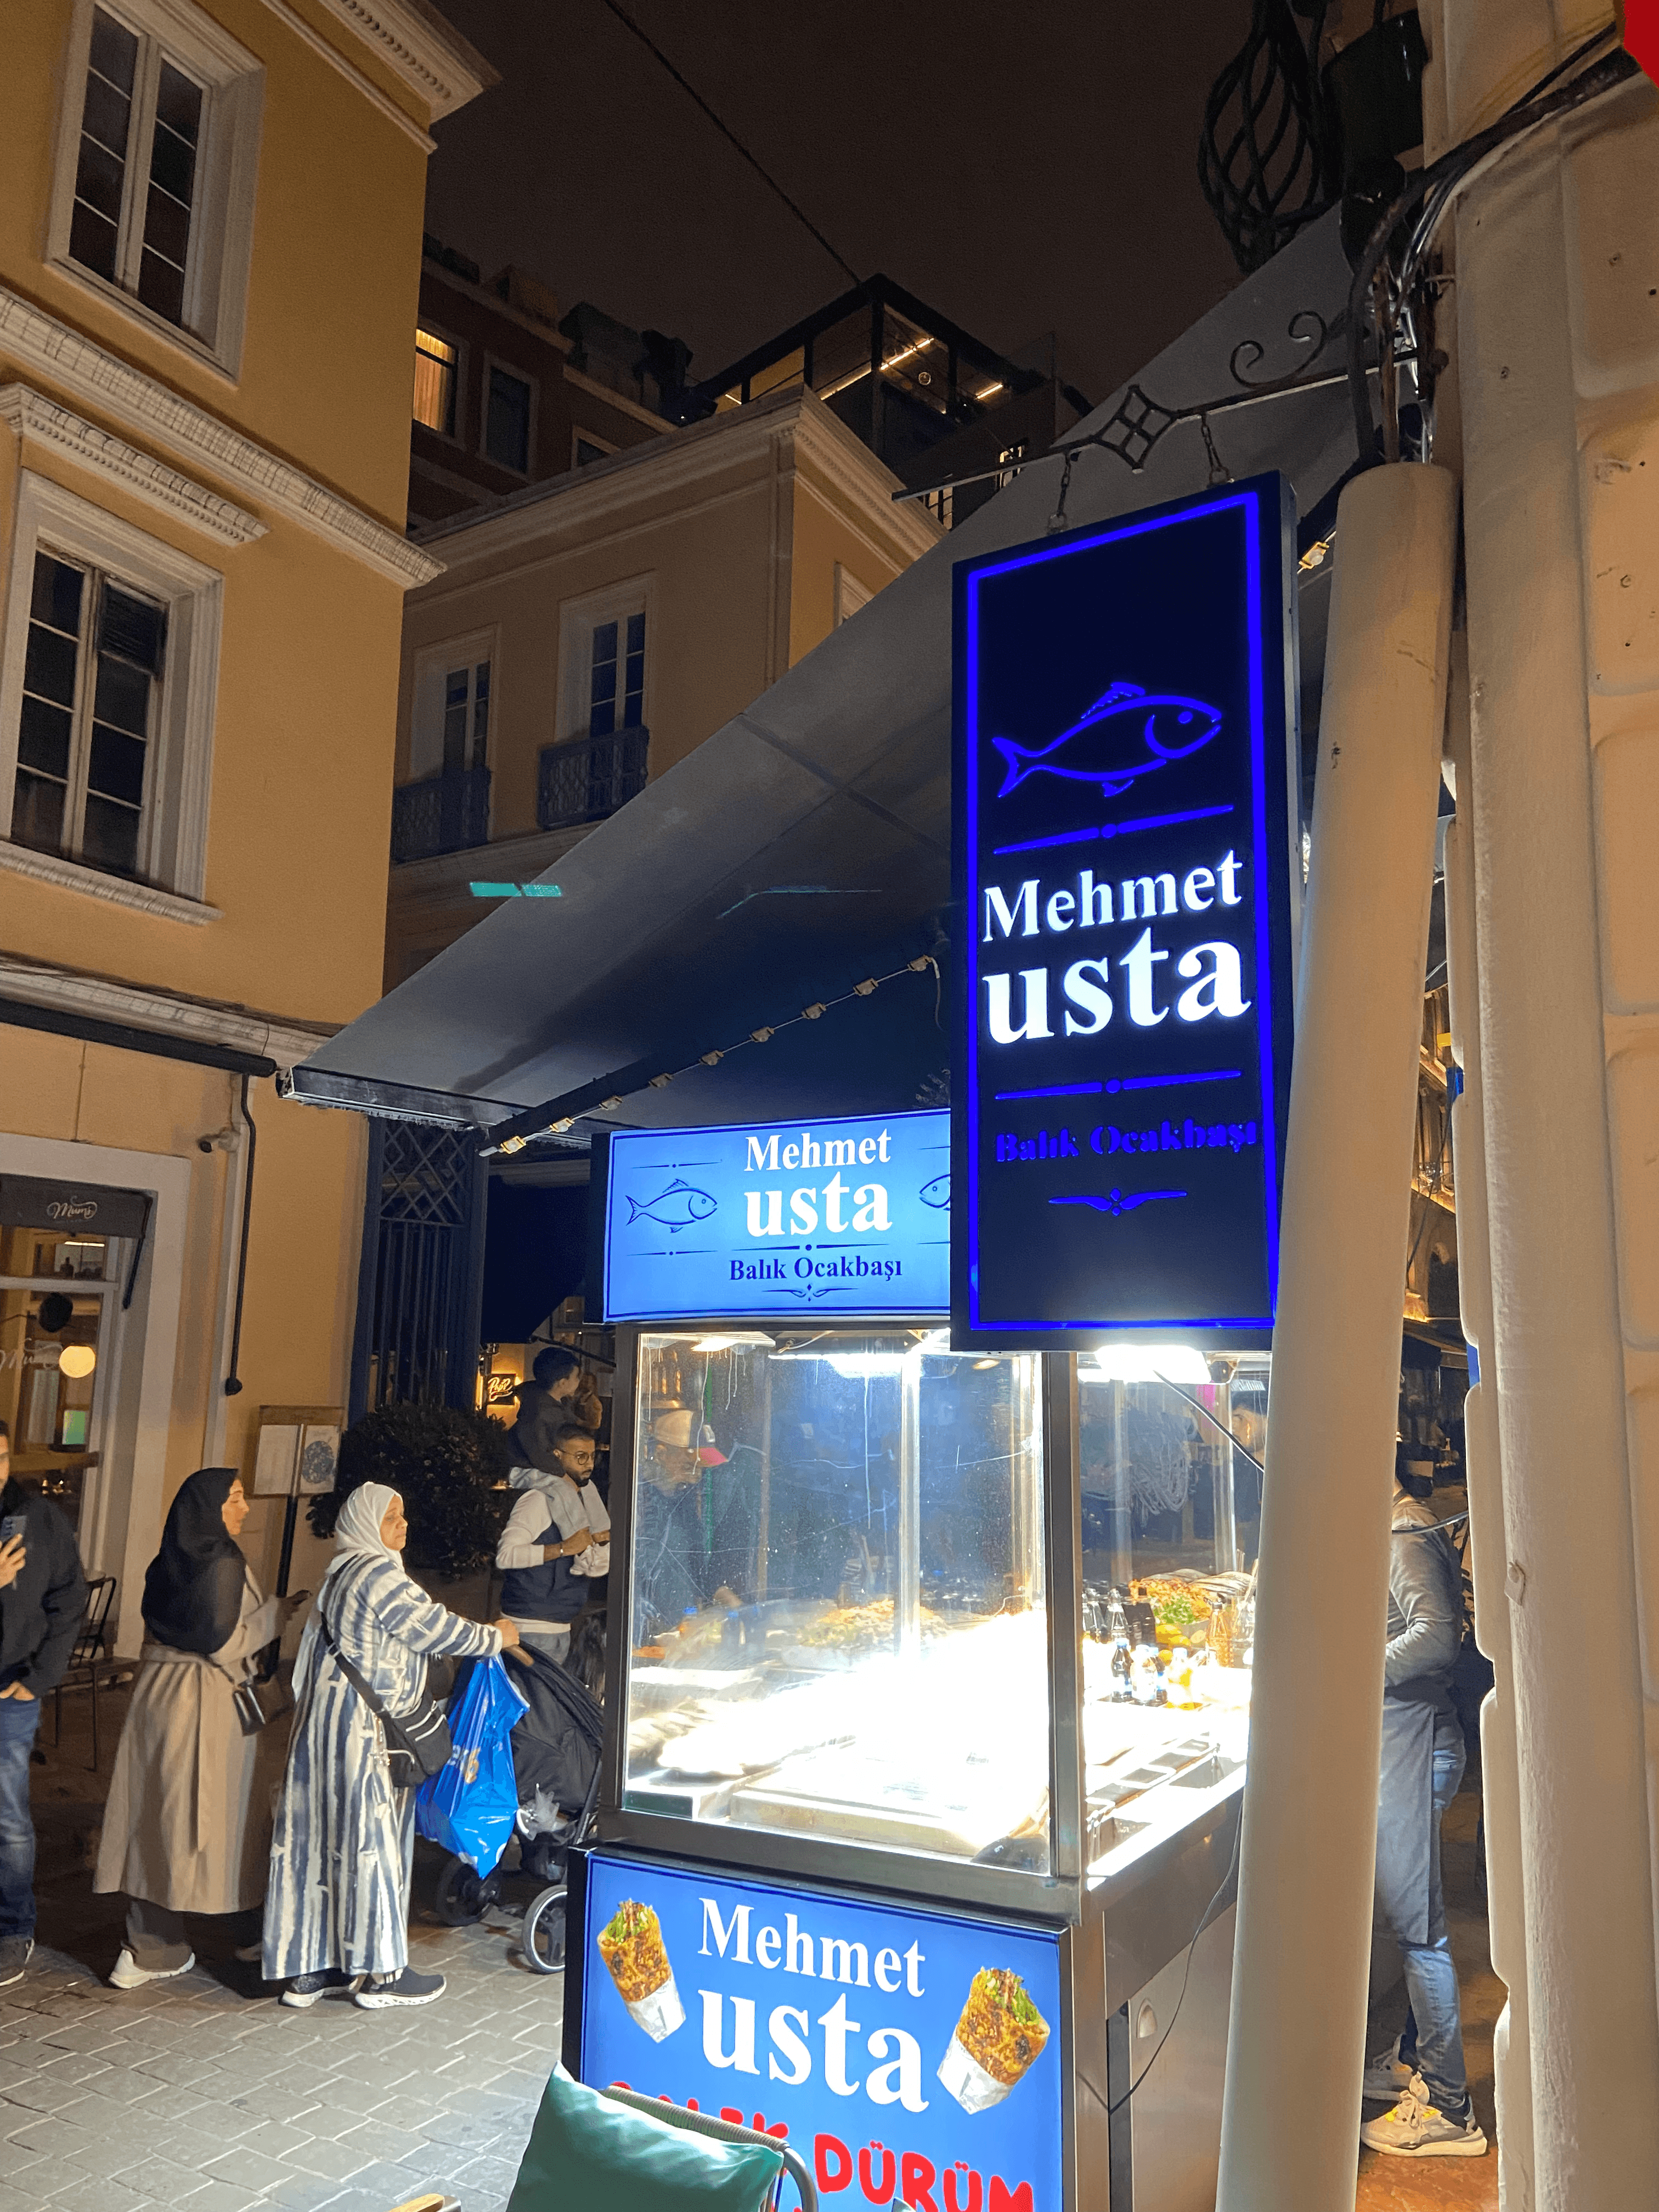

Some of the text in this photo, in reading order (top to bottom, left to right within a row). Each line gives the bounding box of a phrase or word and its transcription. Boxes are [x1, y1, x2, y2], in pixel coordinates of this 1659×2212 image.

[983, 849, 1243, 942] Mehmet
[981, 927, 1252, 1044] usta
[744, 1128, 892, 1171] Mehmet
[996, 1118, 1257, 1163] Balık Ocakbaşı
[744, 1171, 893, 1237] usta
[730, 1255, 903, 1282] Balık Ocakbaşı
[697, 1898, 926, 1997] Mehmet
[697, 1989, 929, 2113] usta
[814, 2134, 1034, 2212] DÜRÜM
